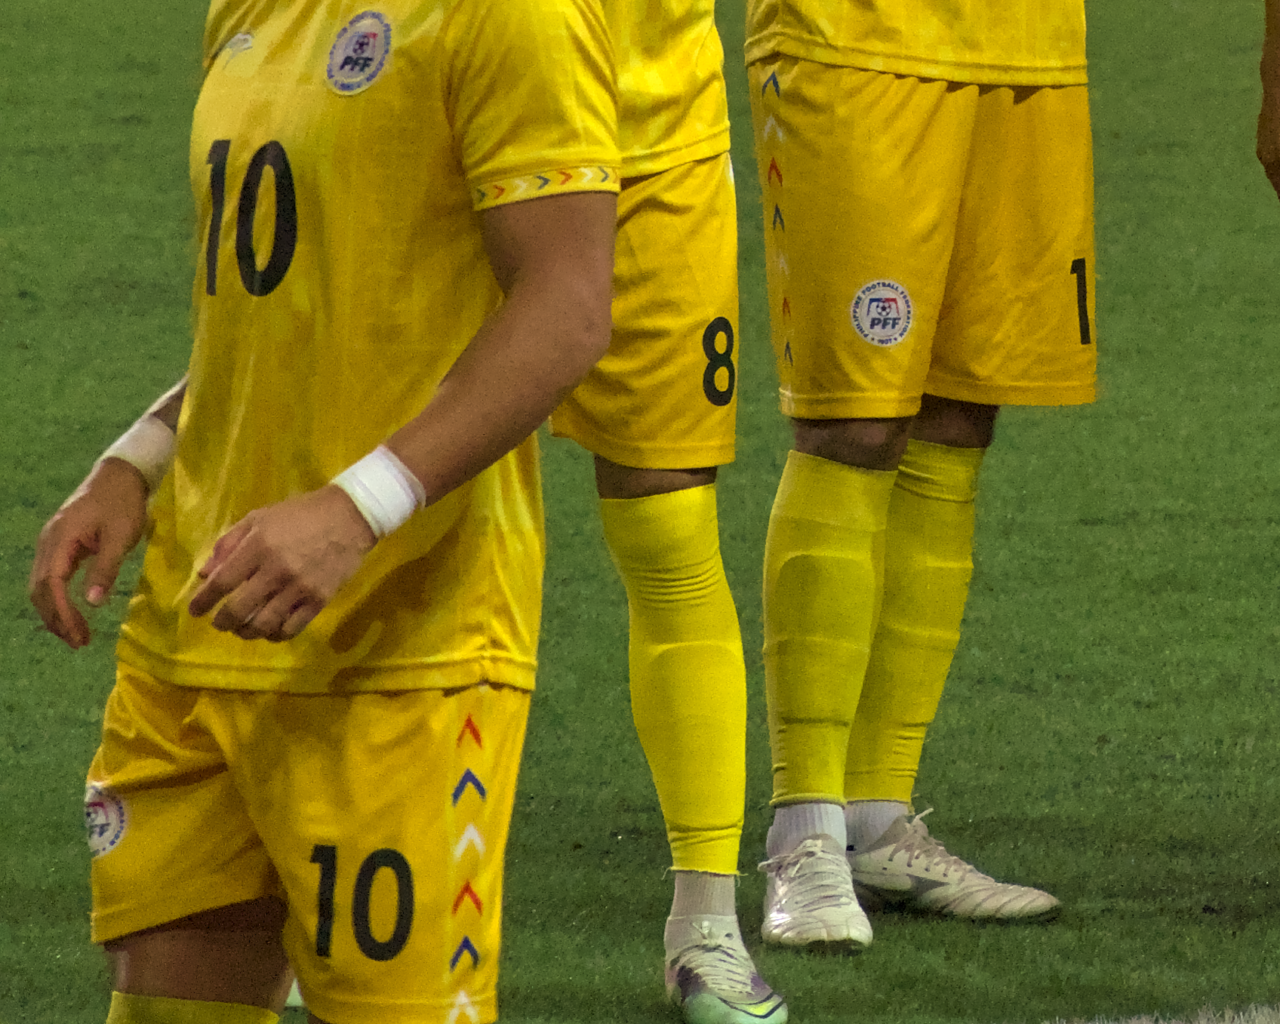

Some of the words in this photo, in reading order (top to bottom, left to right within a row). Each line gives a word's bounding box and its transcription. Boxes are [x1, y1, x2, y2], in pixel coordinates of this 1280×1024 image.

[339, 56, 374, 72] PFF
[206, 139, 297, 297] 10
[861, 282, 899, 295] FOOTBALL
[869, 317, 901, 330] PFF
[1070, 257, 1091, 345] 1
[702, 317, 735, 406] 8
[310, 844, 414, 961] 10
